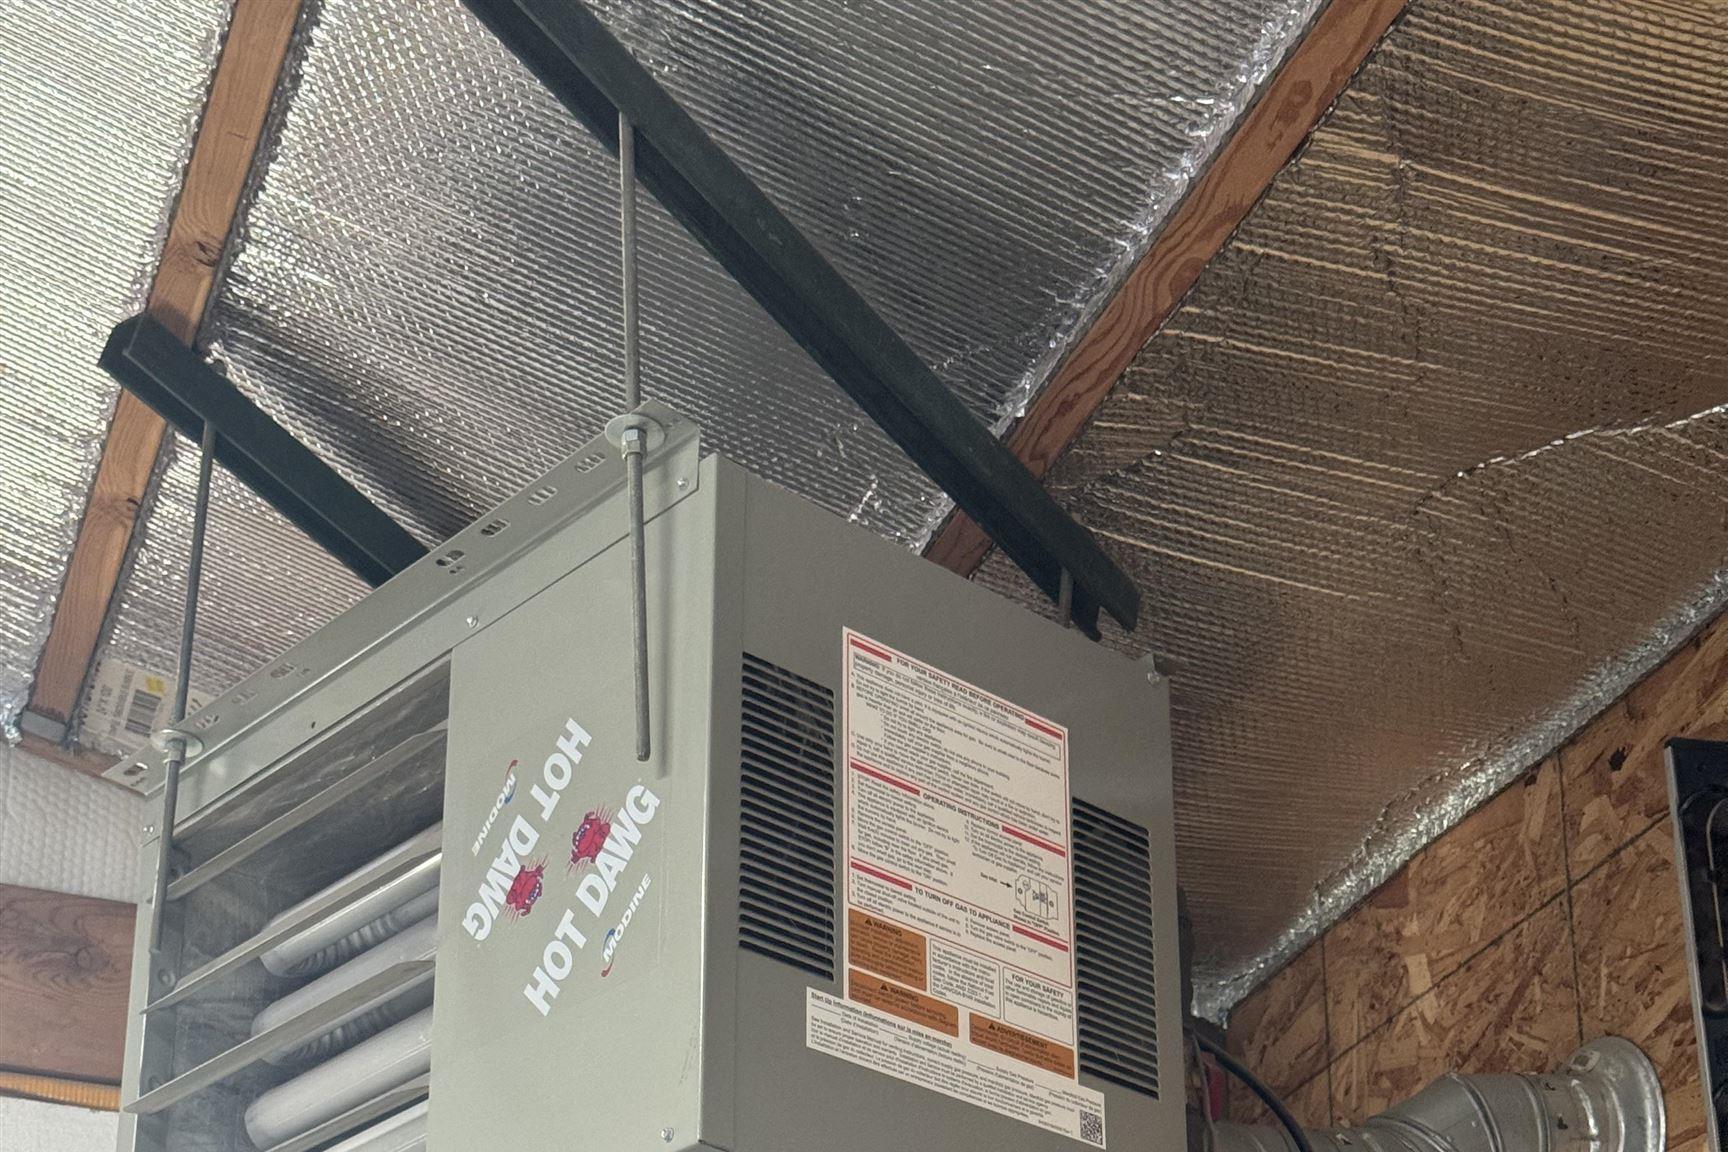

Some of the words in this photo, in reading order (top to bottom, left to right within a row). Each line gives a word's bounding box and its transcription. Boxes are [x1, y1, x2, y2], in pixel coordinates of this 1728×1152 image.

[896, 656, 909, 668] FOR
[910, 663, 927, 677] YOUR
[927, 671, 950, 687] SAFETY
[951, 681, 967, 695] READ
[968, 689, 991, 706] BEFORE
[992, 700, 1024, 721] OPERATING
[531, 718, 592, 821] HOT
[471, 773, 516, 857] MODINE
[922, 791, 956, 813] OPERATING
[957, 806, 999, 831] INSTRUCTIONS
[462, 815, 540, 942] DAWG
[523, 909, 587, 1017] HOT
[576, 785, 660, 918] DAWG
[914, 885, 923, 896] TO
[924, 890, 941, 903] TURN
[941, 896, 953, 908] OFF
[954, 901, 968, 914] GAS
[969, 907, 976, 917] TO
[977, 911, 1010, 931] APPLIANCE
[604, 873, 651, 963] MODINE
[873, 919, 902, 937] WARNING
[1011, 973, 1023, 984] FOR
[1025, 978, 1041, 990] YOUR
[1041, 984, 1064, 999] SAFETY
